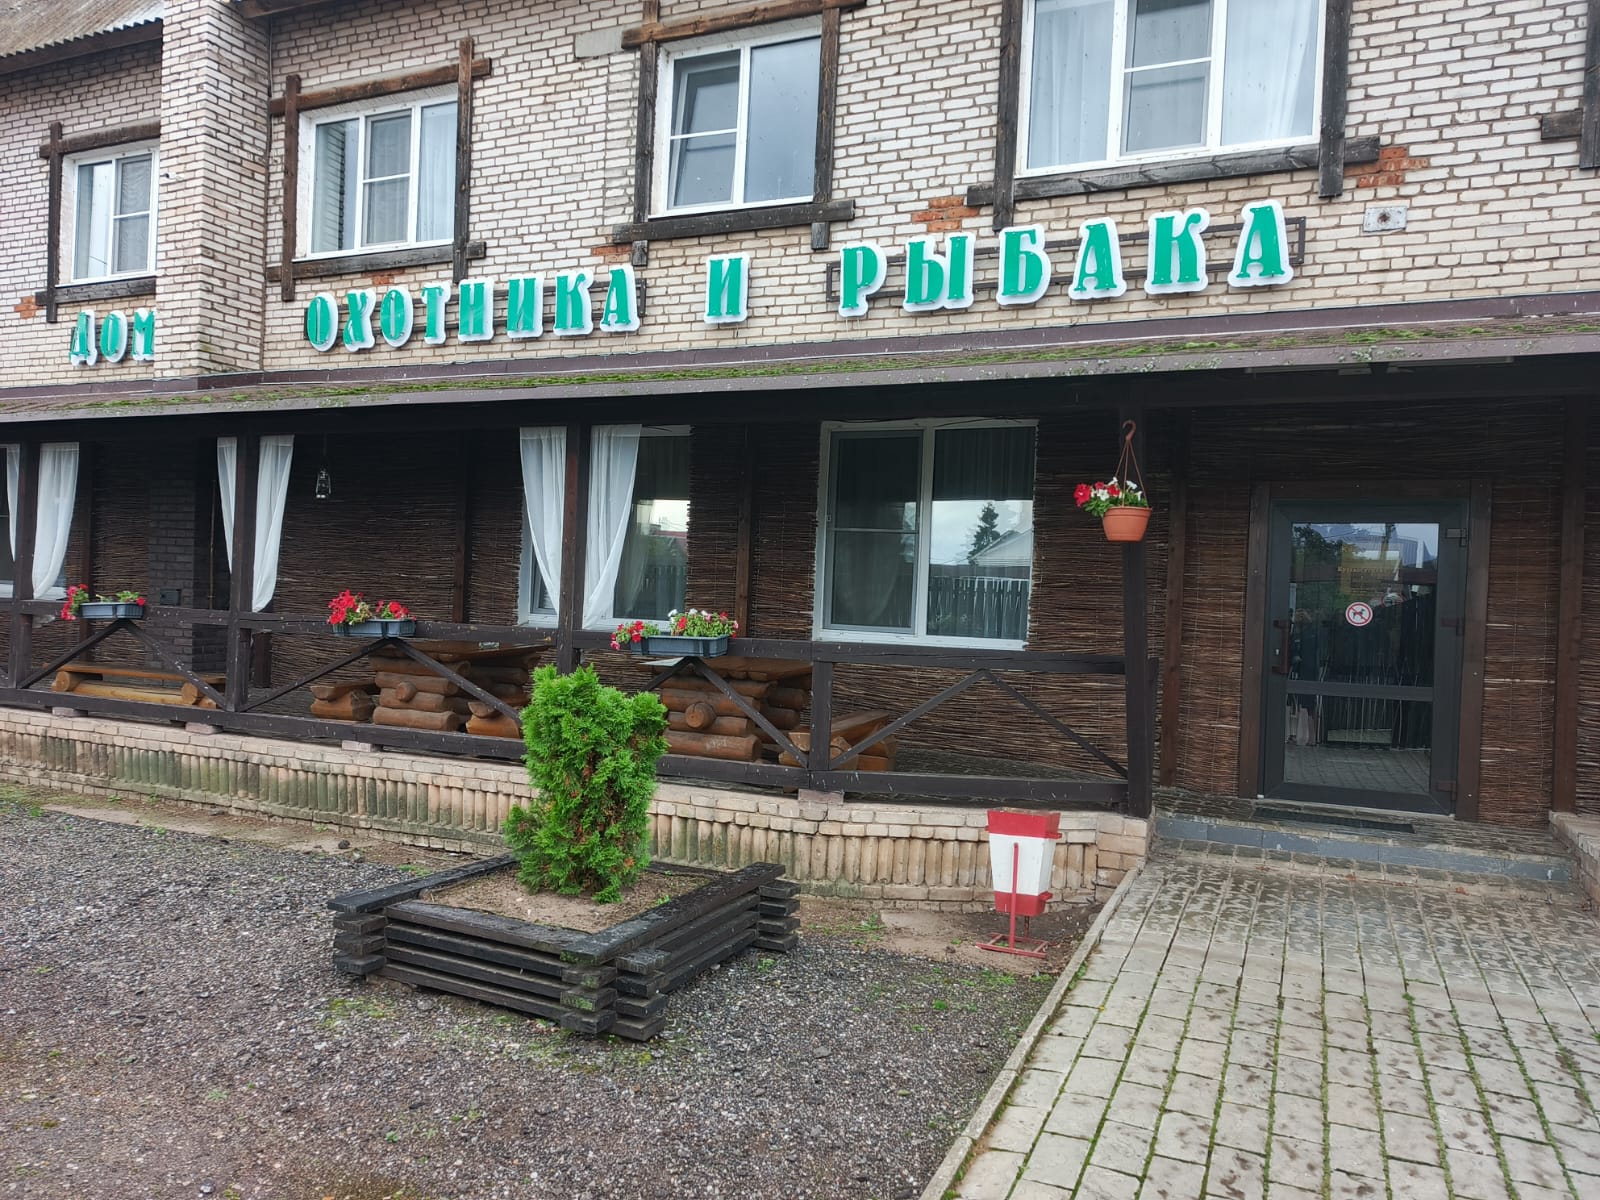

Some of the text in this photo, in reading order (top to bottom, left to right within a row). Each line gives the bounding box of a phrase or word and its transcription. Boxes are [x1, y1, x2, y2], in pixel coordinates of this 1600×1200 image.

[68, 202, 1291, 364] ДОМ ОХОТНИКА И РЫБАКА
